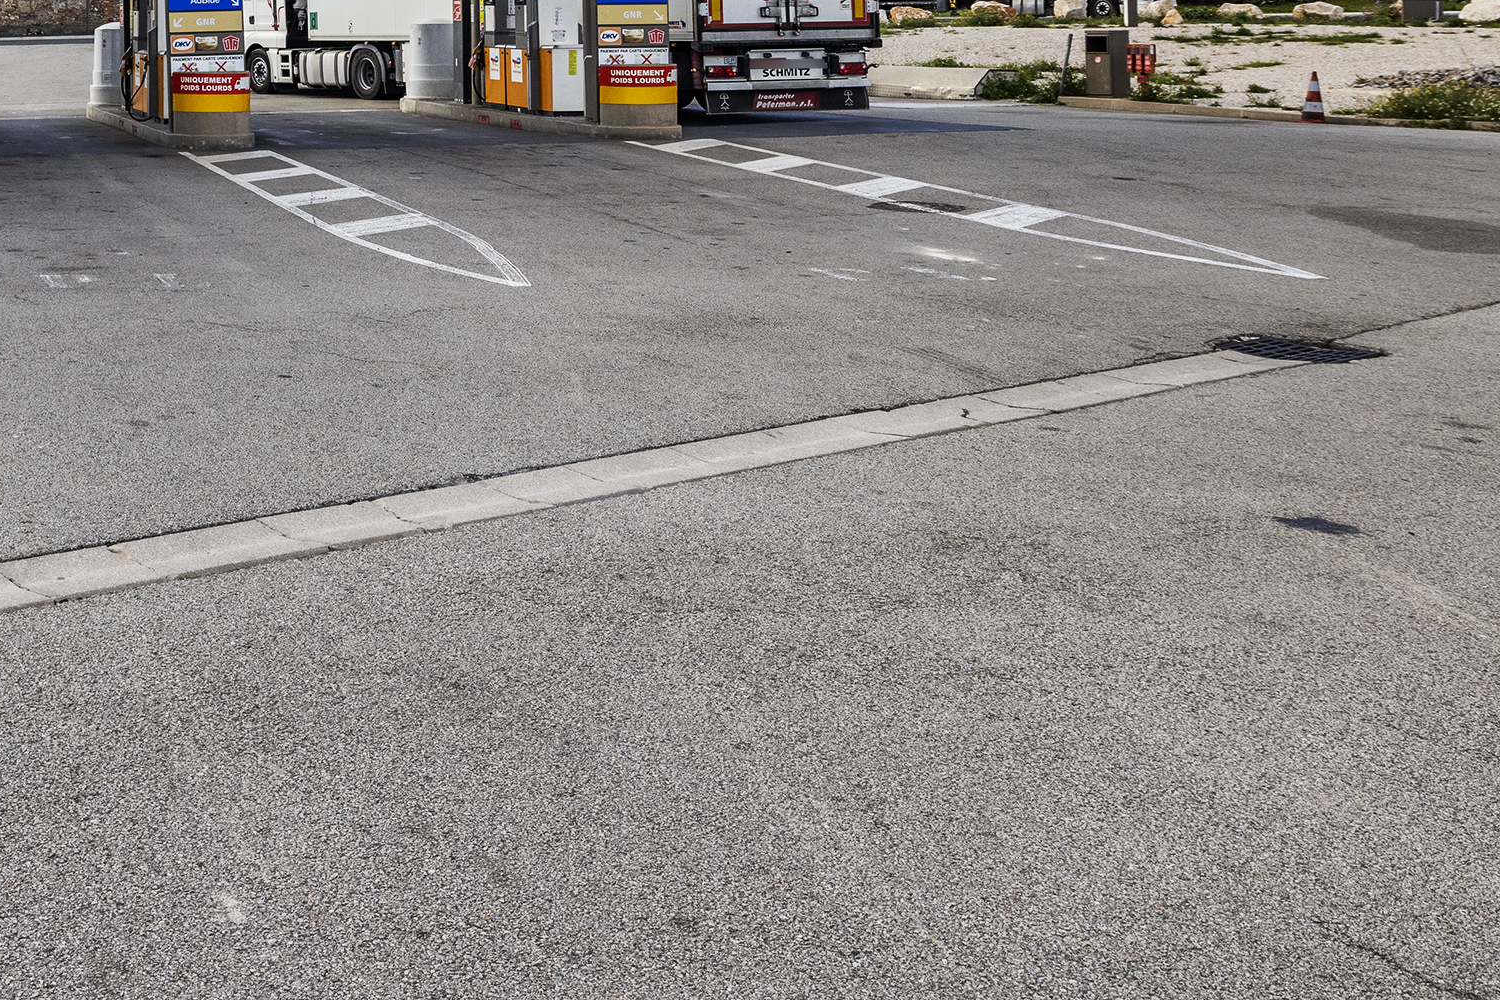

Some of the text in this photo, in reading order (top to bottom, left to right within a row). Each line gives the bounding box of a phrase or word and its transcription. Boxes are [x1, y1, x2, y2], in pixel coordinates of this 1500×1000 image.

[623, 10, 642, 19] GNR
[196, 17, 216, 26] GNR
[311, 14, 316, 29] d
[648, 29, 665, 44] UTA
[223, 36, 239, 51] UTA
[762, 67, 810, 78] SCHMITZ
[180, 76, 232, 84] UNIQUEMENT
[757, 93, 795, 101] transportes
